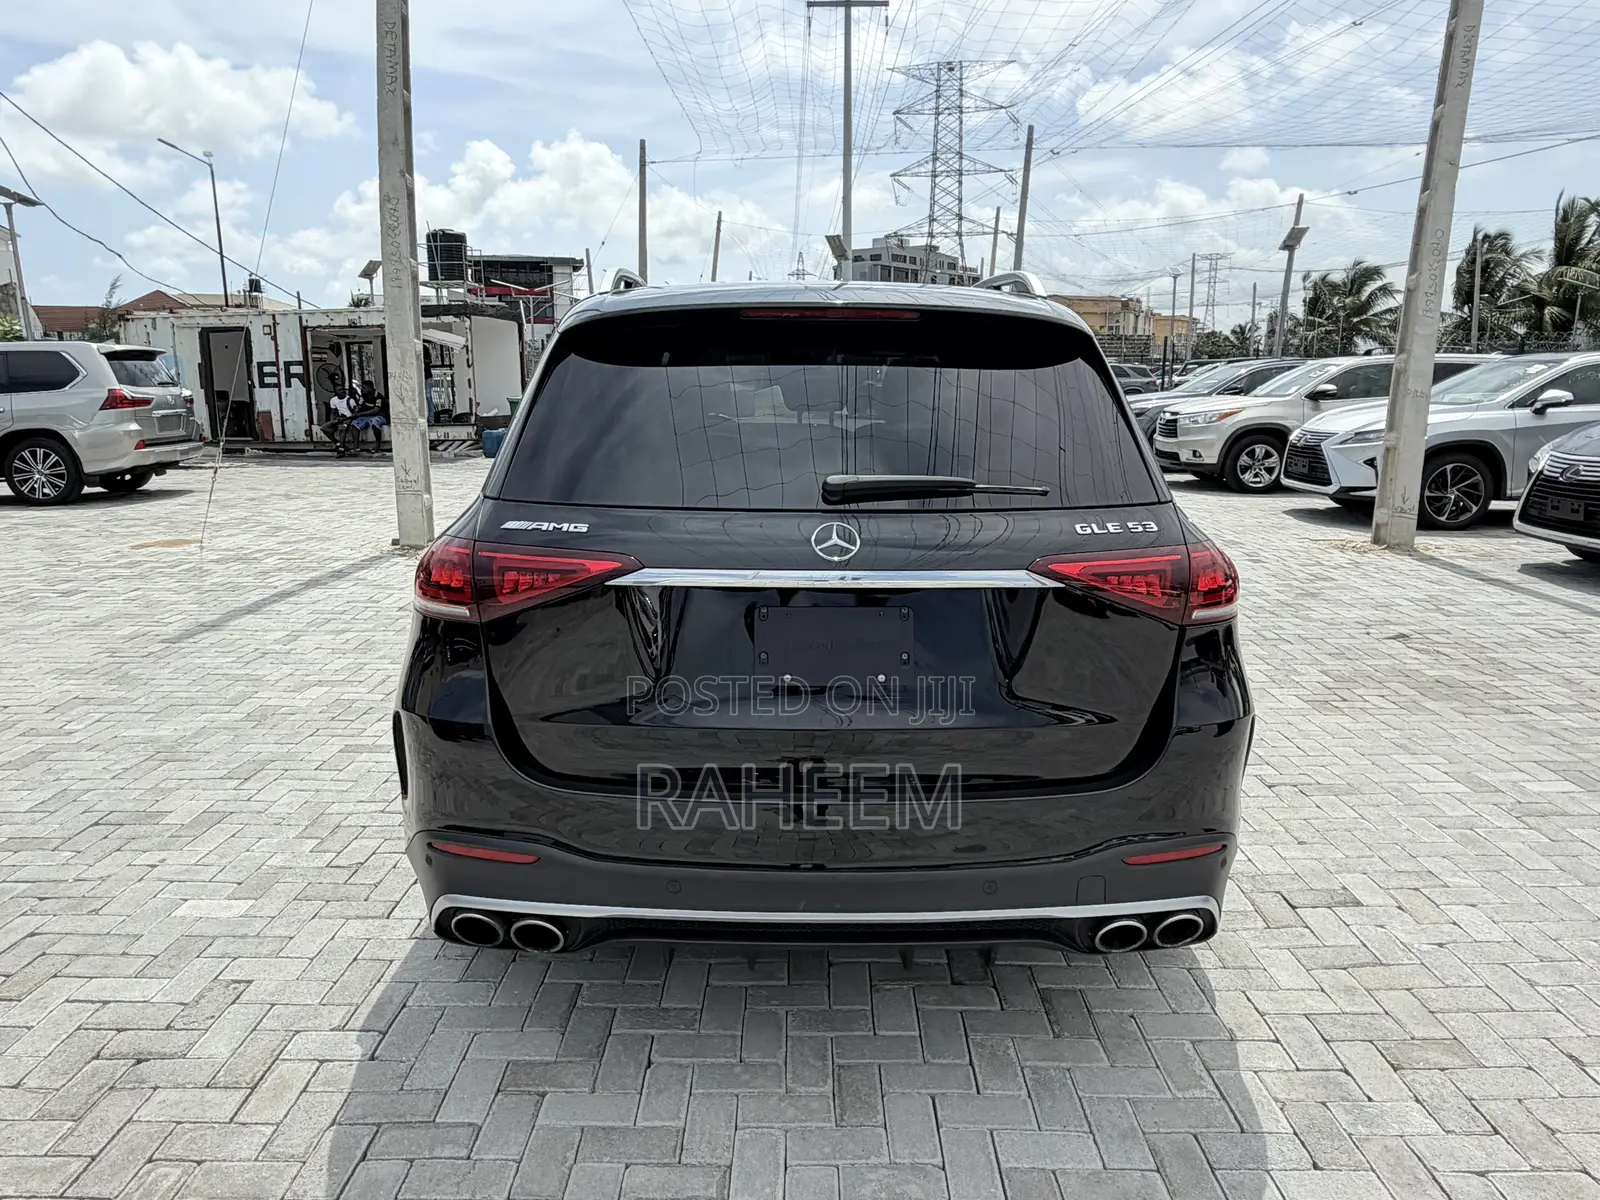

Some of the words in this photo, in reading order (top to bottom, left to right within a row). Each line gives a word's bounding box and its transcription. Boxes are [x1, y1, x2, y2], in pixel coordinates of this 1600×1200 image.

[526, 521, 589, 533] AMG
[1074, 522, 1124, 535] GLE
[1126, 521, 1159, 533] 53
